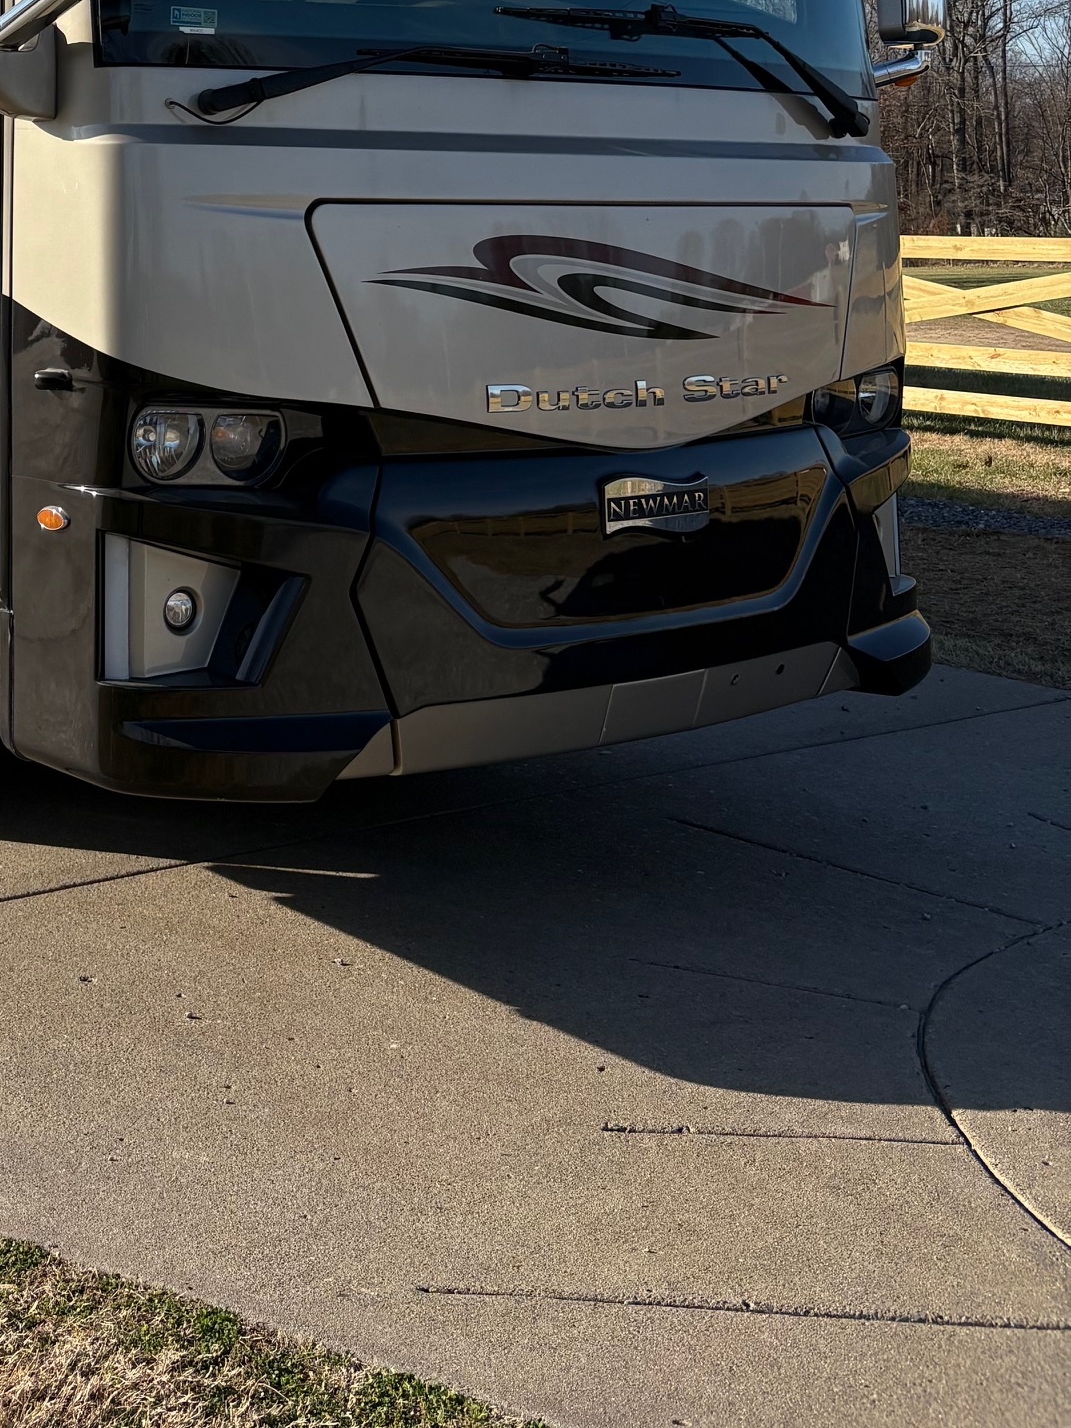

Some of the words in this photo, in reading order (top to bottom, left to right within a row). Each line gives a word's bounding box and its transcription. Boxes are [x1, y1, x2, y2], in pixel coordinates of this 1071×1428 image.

[486, 379, 665, 414] Dutch
[682, 373, 788, 403] Star
[609, 491, 708, 521] NEWMAR
